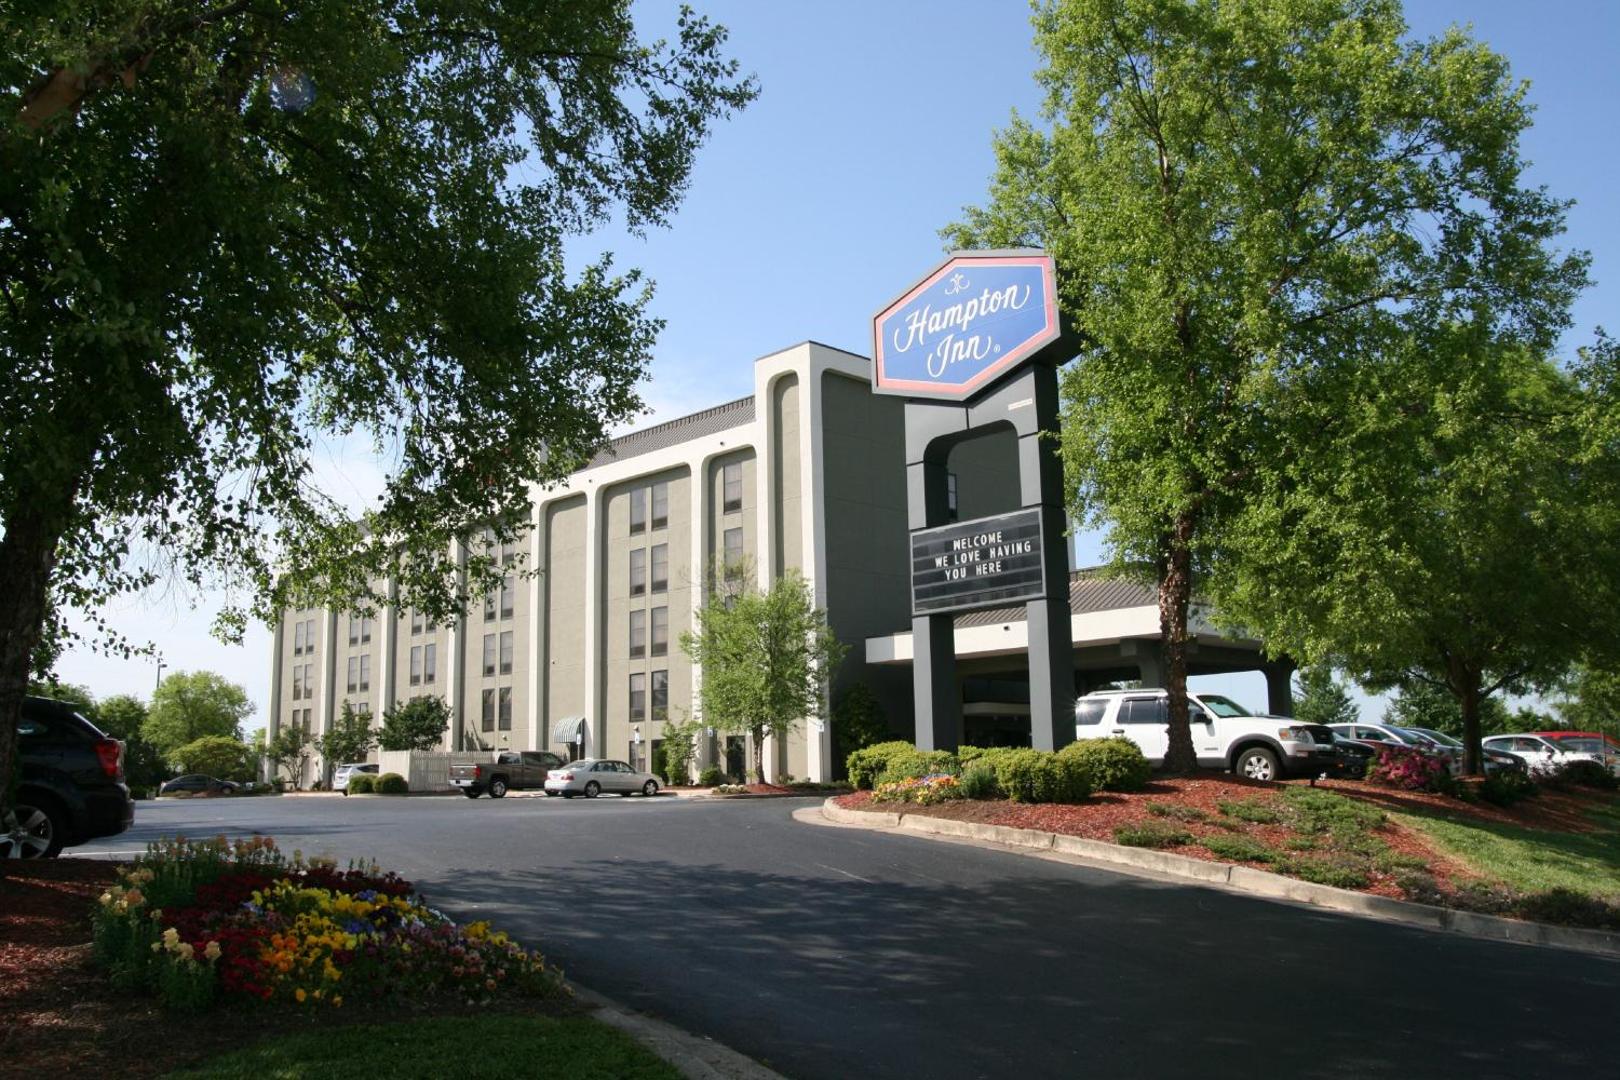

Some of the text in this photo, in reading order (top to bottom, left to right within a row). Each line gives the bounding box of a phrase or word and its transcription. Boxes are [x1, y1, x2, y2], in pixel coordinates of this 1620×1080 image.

[894, 284, 1030, 352] Hampton
[927, 333, 992, 378] Inn
[935, 541, 1031, 568] WE LOVE HAVING
[953, 531, 1003, 551] WELCOME
[945, 561, 1001, 581] YOU HERE
